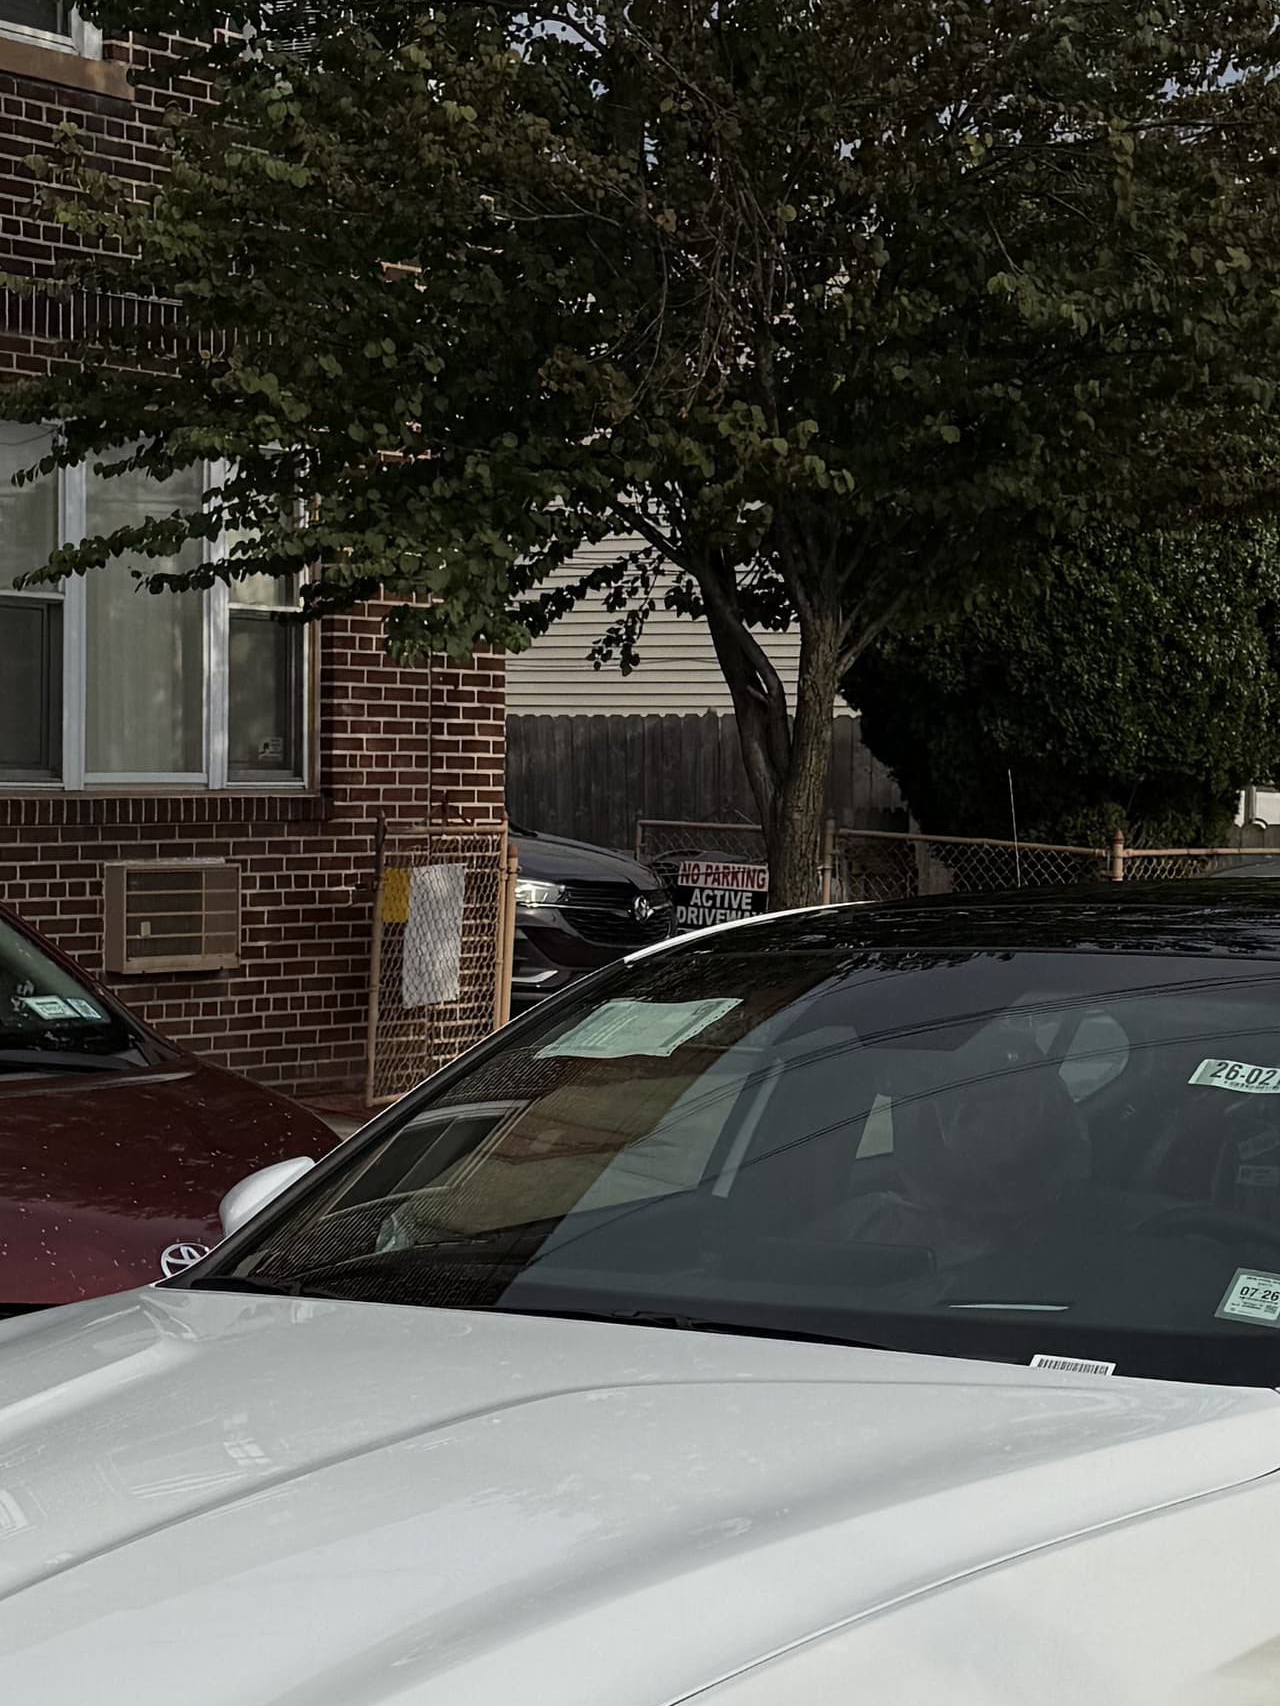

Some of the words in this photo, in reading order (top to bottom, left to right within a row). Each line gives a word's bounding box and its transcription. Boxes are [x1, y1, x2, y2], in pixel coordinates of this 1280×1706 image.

[681, 863, 700, 885] NO
[704, 864, 766, 889] PARKING
[690, 888, 753, 910] ACTIVE
[677, 906, 764, 925] DRIVEW
[1240, 1286, 1259, 1297] 07
[1261, 1290, 1280, 1301] 26
